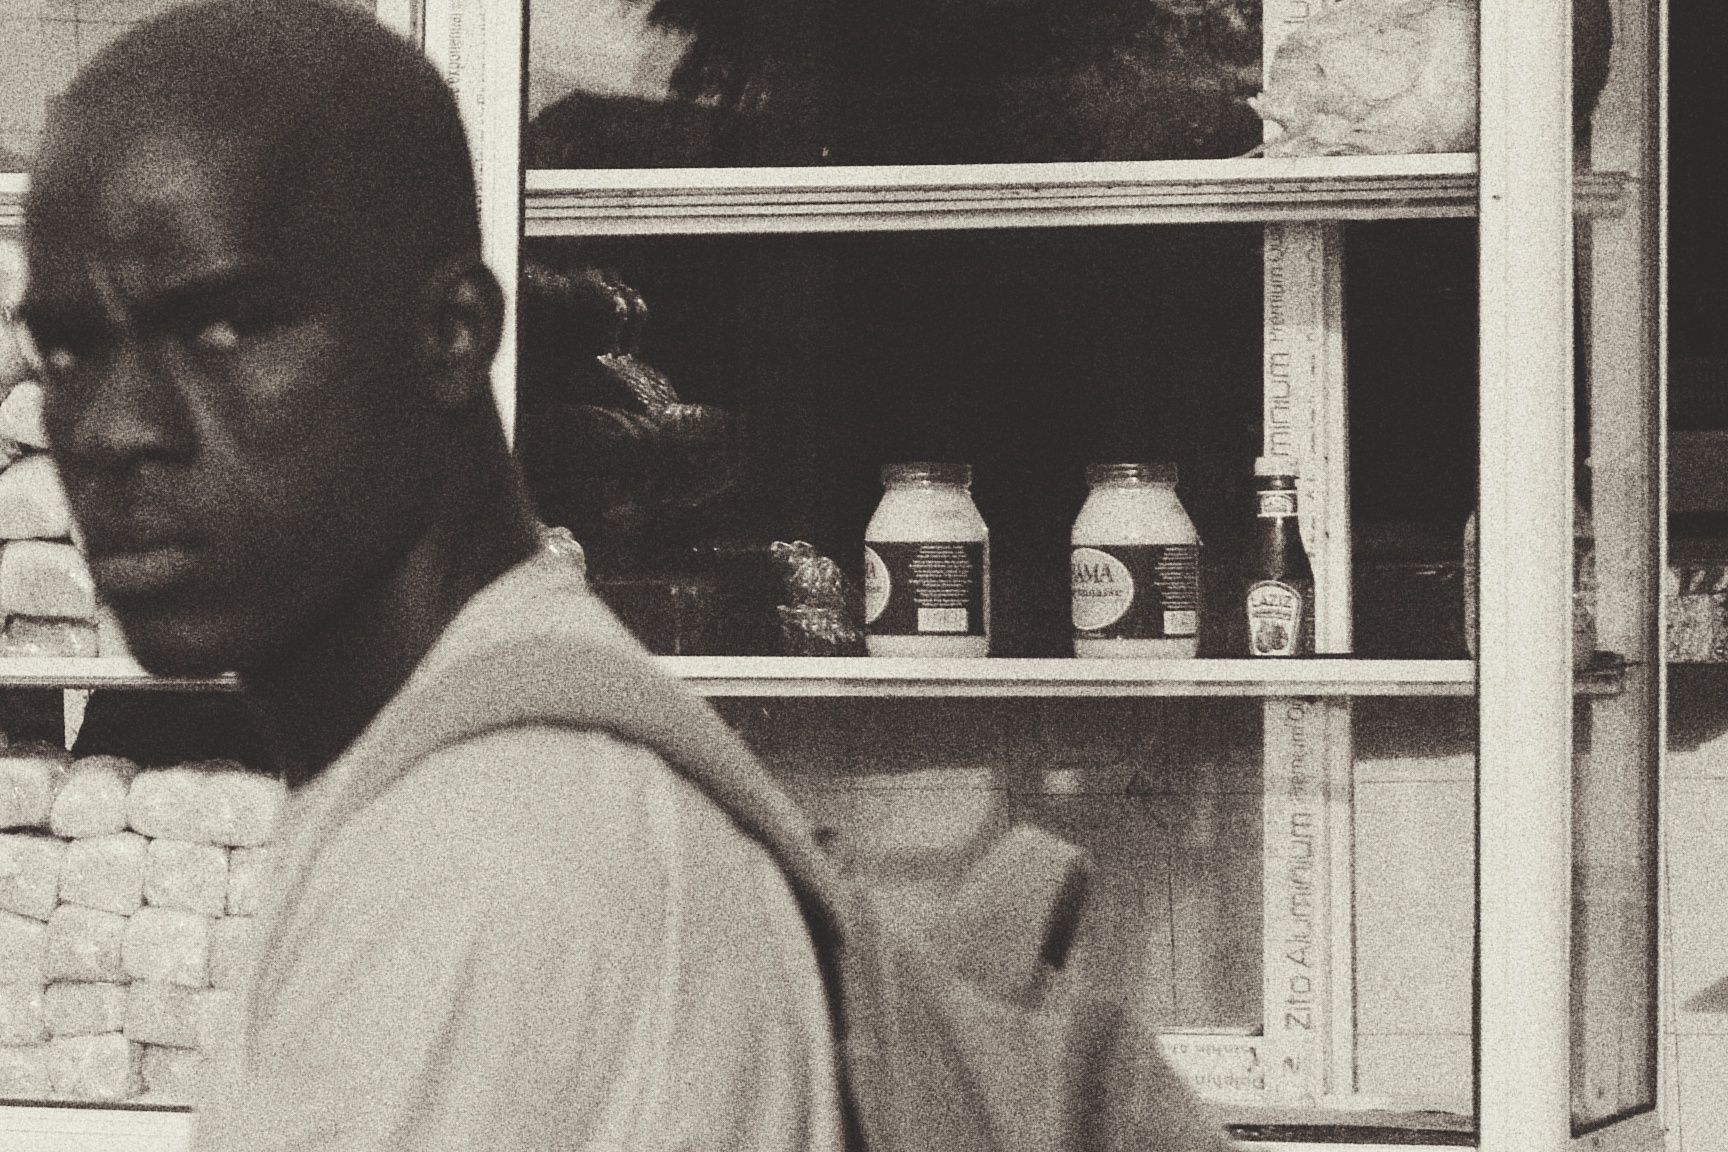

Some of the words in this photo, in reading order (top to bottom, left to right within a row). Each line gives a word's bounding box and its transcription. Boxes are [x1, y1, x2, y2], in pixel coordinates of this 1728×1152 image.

[1269, 352, 1291, 457] minium
[1285, 811, 1314, 969] Aluminium
[1284, 973, 1313, 1031] Zito
